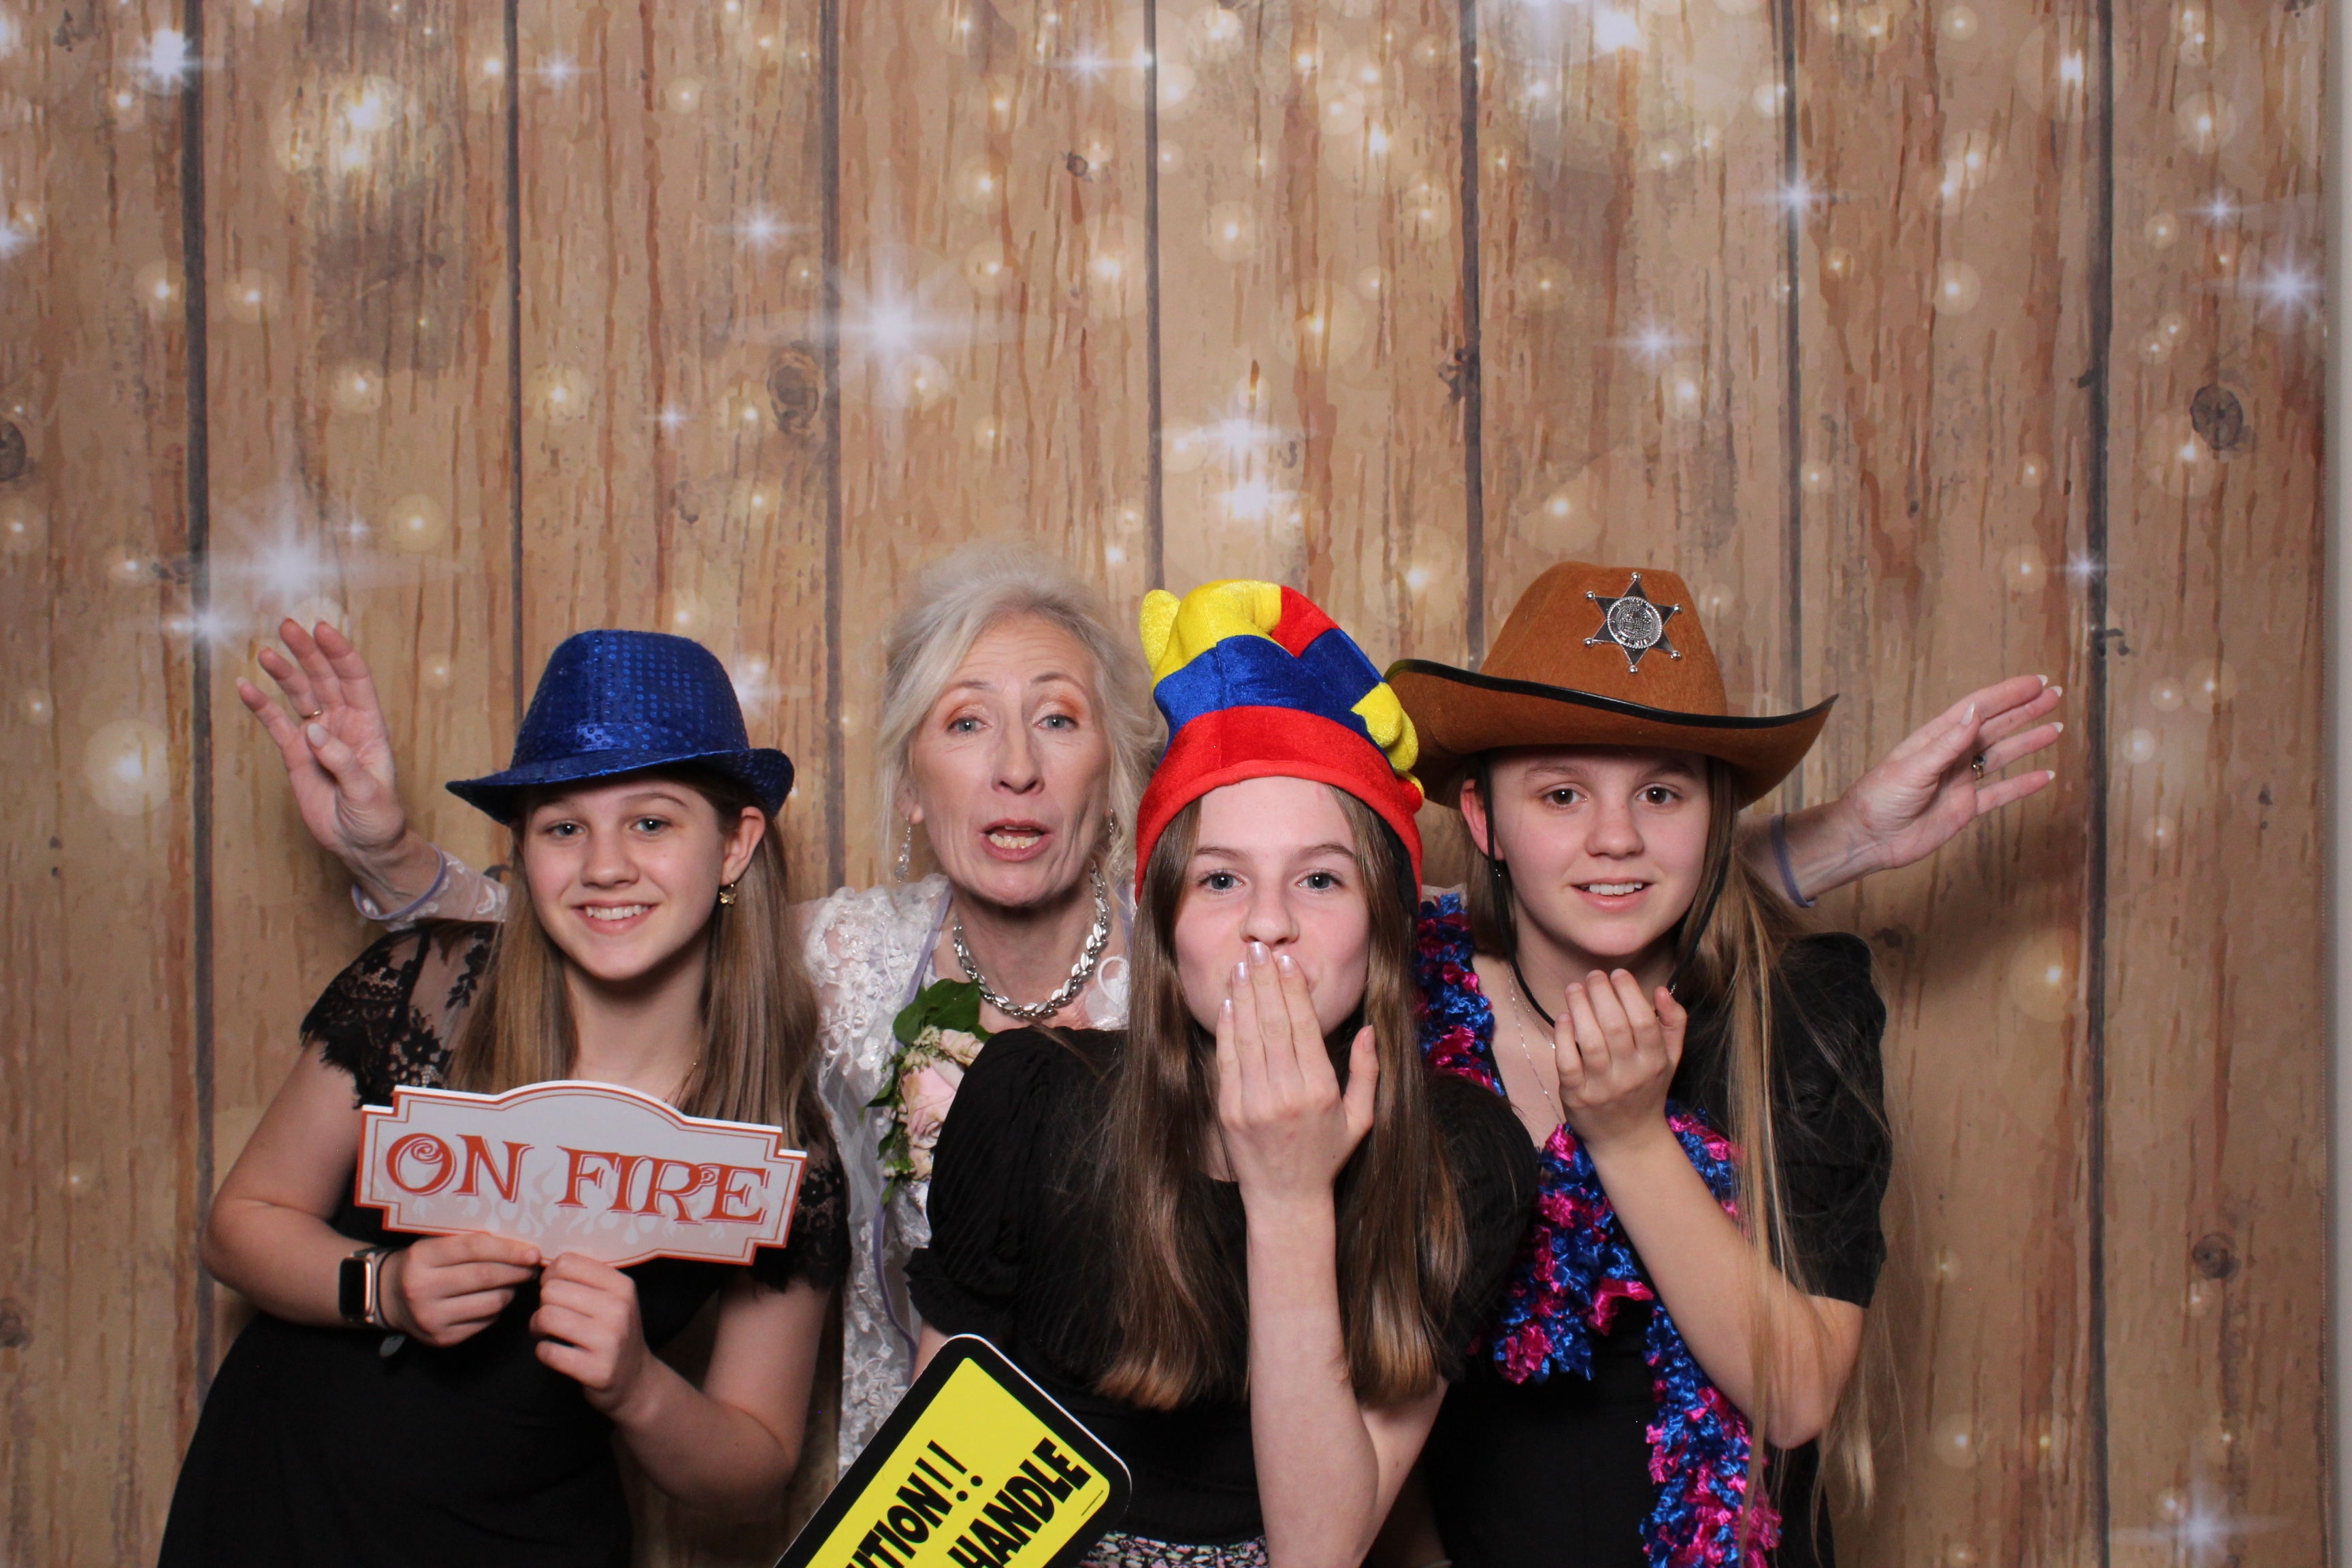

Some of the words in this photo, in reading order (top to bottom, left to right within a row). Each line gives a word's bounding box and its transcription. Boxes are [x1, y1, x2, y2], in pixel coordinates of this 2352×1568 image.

[386, 1132, 534, 1203] ON
[555, 1145, 771, 1224] FIRE
[845, 1440, 983, 1568] TION!!
[947, 1437, 1092, 1568] HANDLE
